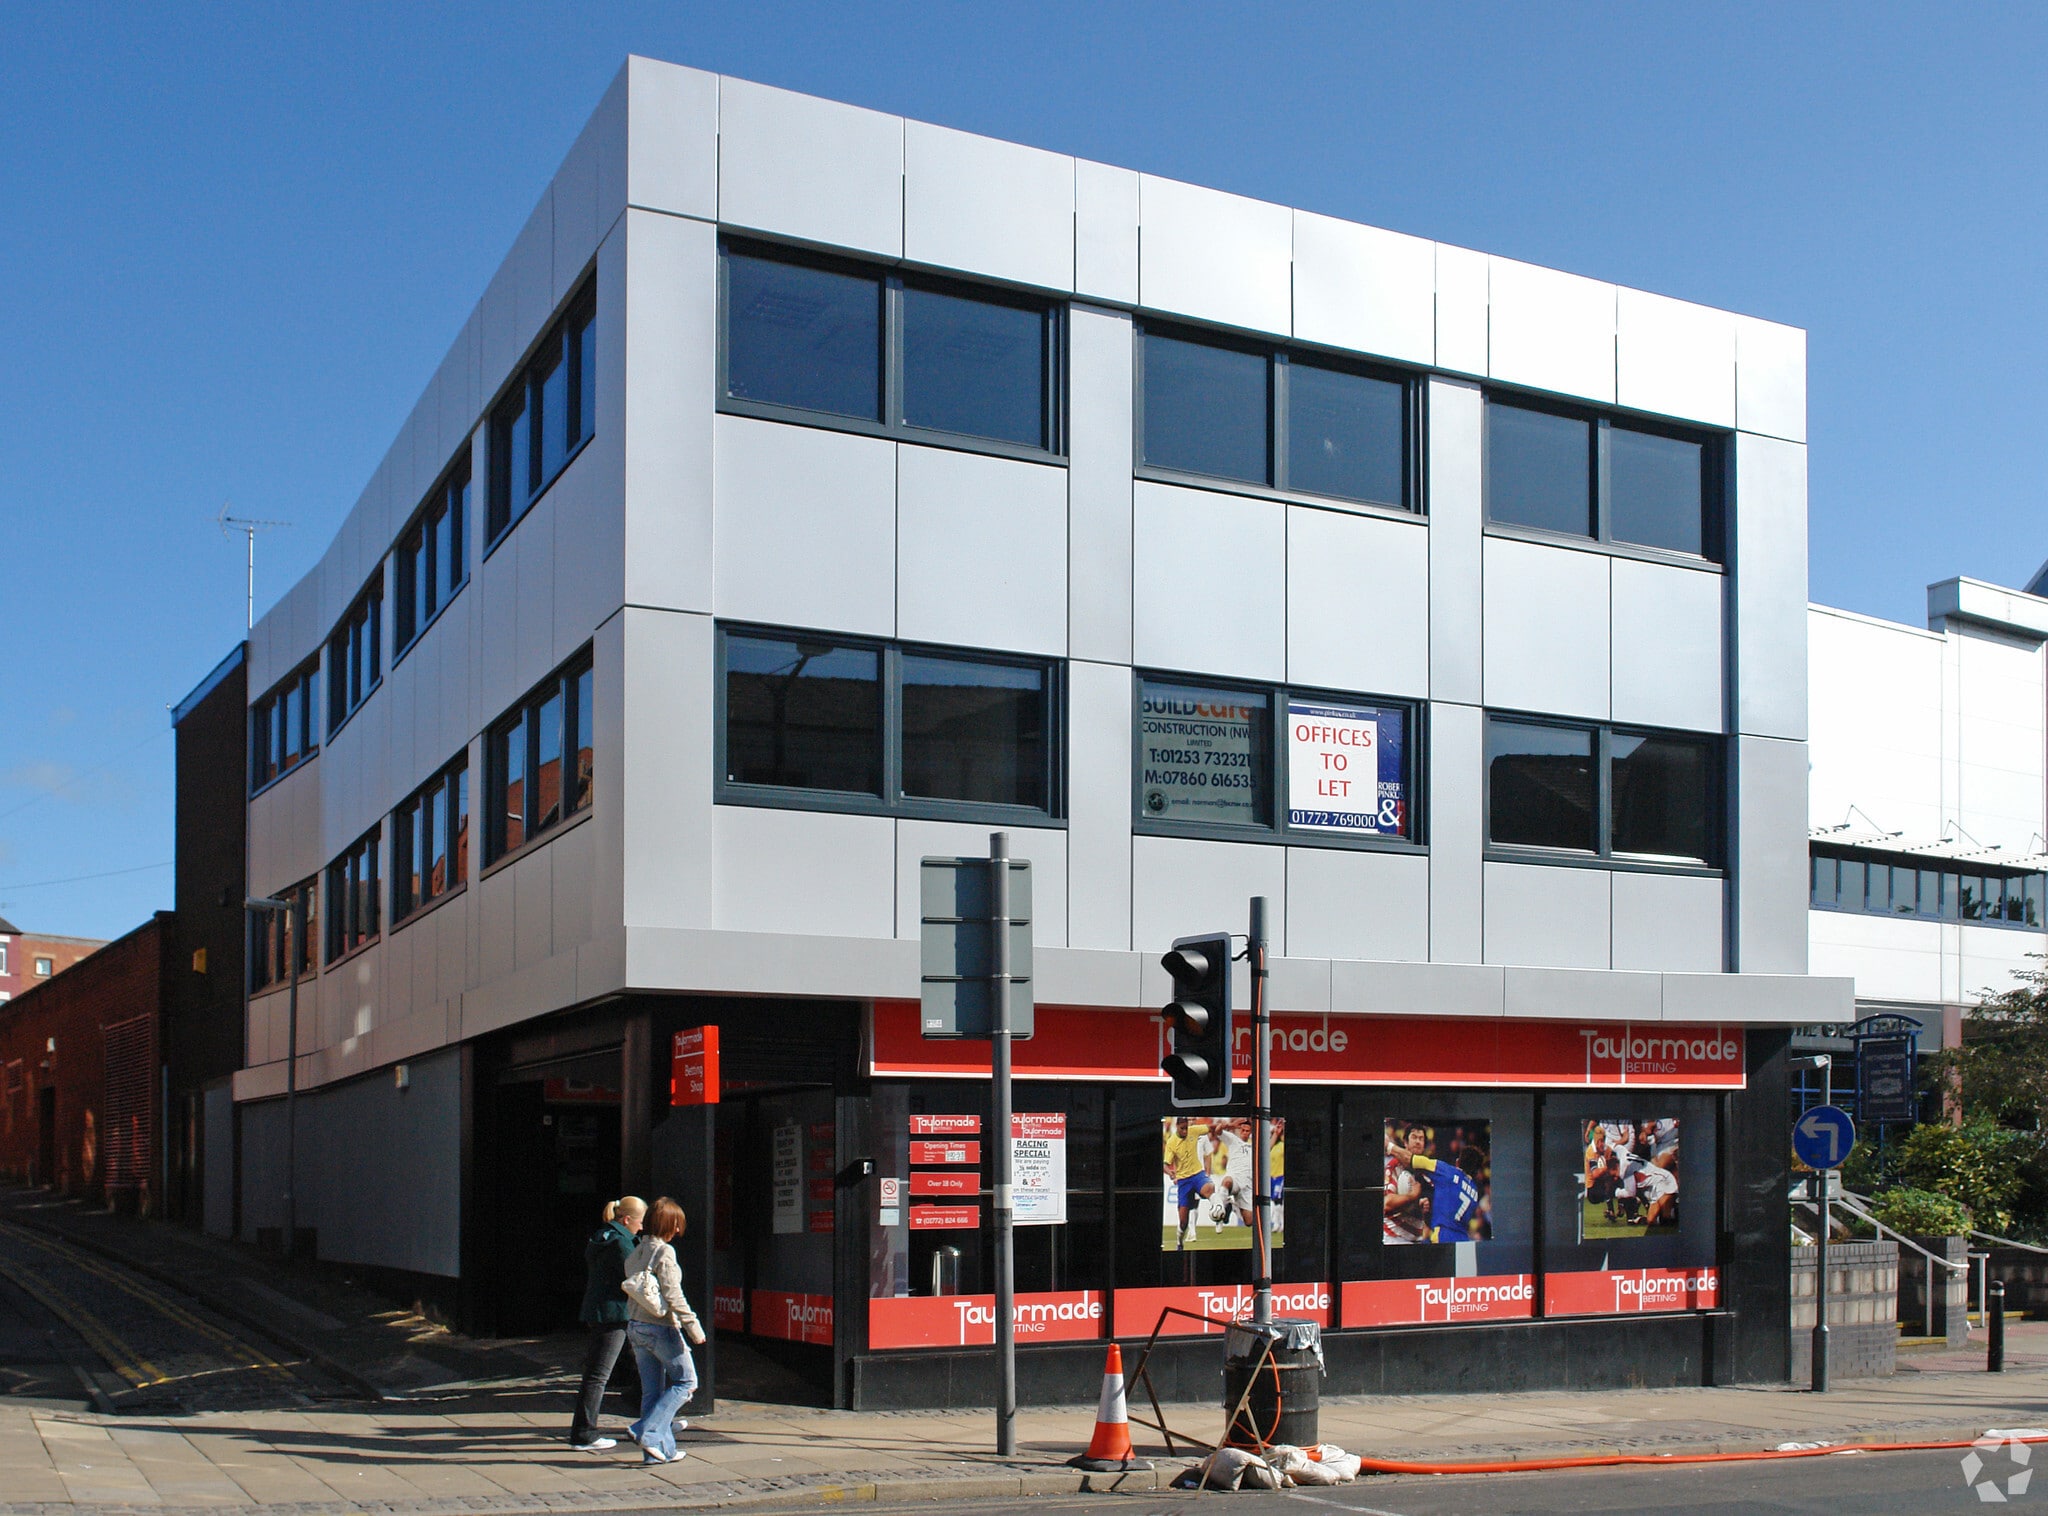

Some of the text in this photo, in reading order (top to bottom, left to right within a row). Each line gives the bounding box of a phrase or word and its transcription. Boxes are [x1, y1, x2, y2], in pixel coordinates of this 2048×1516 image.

[1142, 721, 1227, 737] CONSTRUCTION
[1295, 724, 1372, 747] OFFICES
[1186, 739, 1212, 748] LIMITED
[1149, 748, 1200, 765] T:01253
[1320, 753, 1347, 771] TO
[1144, 769, 1207, 787] M:07860
[1377, 781, 1404, 791] ROBERT
[1318, 779, 1352, 797] LET
[1377, 790, 1404, 799] PINKUS
[1291, 810, 1376, 828] 01772 769000
[1377, 798, 1403, 827] &
[1579, 1021, 1738, 1083] Taylormade
[684, 1064, 704, 1078] Betting
[1626, 1061, 1677, 1073] BETTING
[690, 1080, 704, 1095] Shop
[915, 1114, 975, 1134] Taylormade
[1011, 1113, 1064, 1129] aylormade
[923, 1142, 949, 1150] Opening
[1016, 1140, 1048, 1149] RACING
[1014, 1150, 1051, 1159] SPECIAL!
[949, 1180, 963, 1189] Only
[1022, 1178, 1028, 1186] &
[1454, 1191, 1471, 1222] 7
[1611, 1266, 1719, 1311] Taylormade
[1416, 1274, 1535, 1321] Taylormade
[1643, 1294, 1677, 1303] BETTING
[1198, 1282, 1331, 1333] Taylomade
[1450, 1303, 1489, 1313] BETTING
[954, 1290, 1104, 1345] Tayrmade
